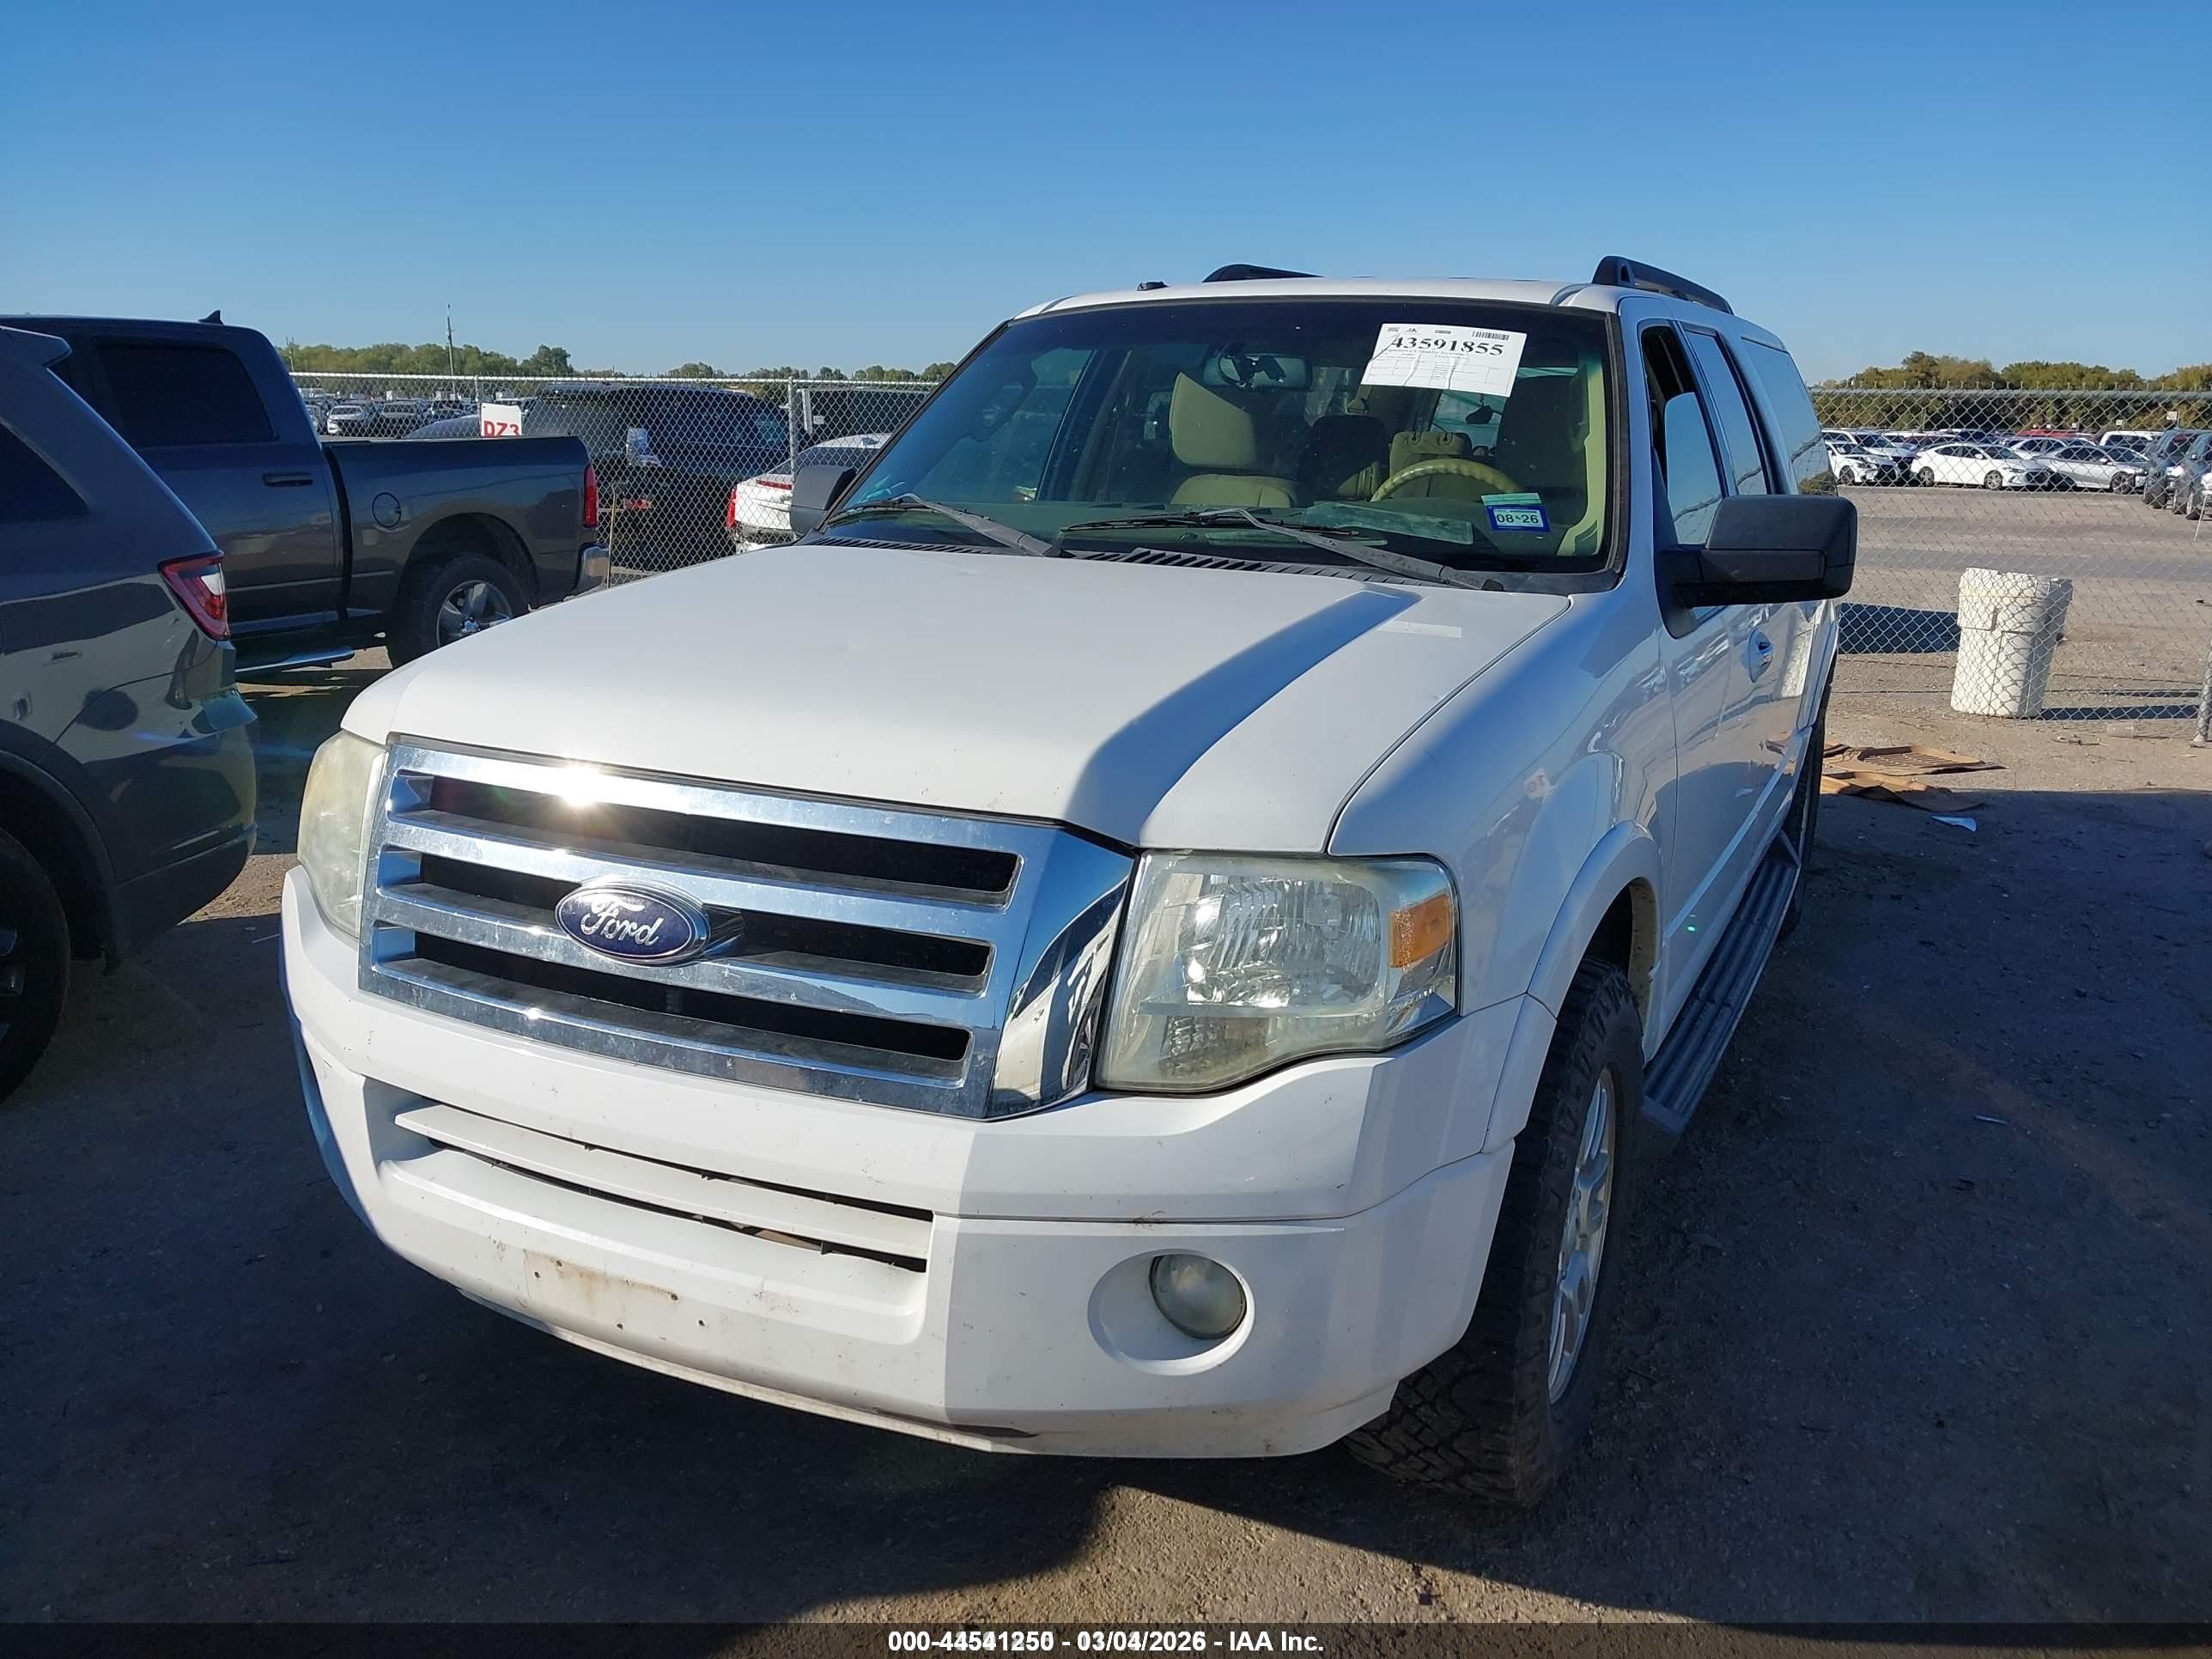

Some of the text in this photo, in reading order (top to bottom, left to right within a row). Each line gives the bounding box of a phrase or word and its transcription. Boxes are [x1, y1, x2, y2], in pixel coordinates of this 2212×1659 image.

[1391, 337, 1504, 356] 43591855
[1497, 514, 1539, 524] 08 26
[580, 896, 665, 946] Ford
